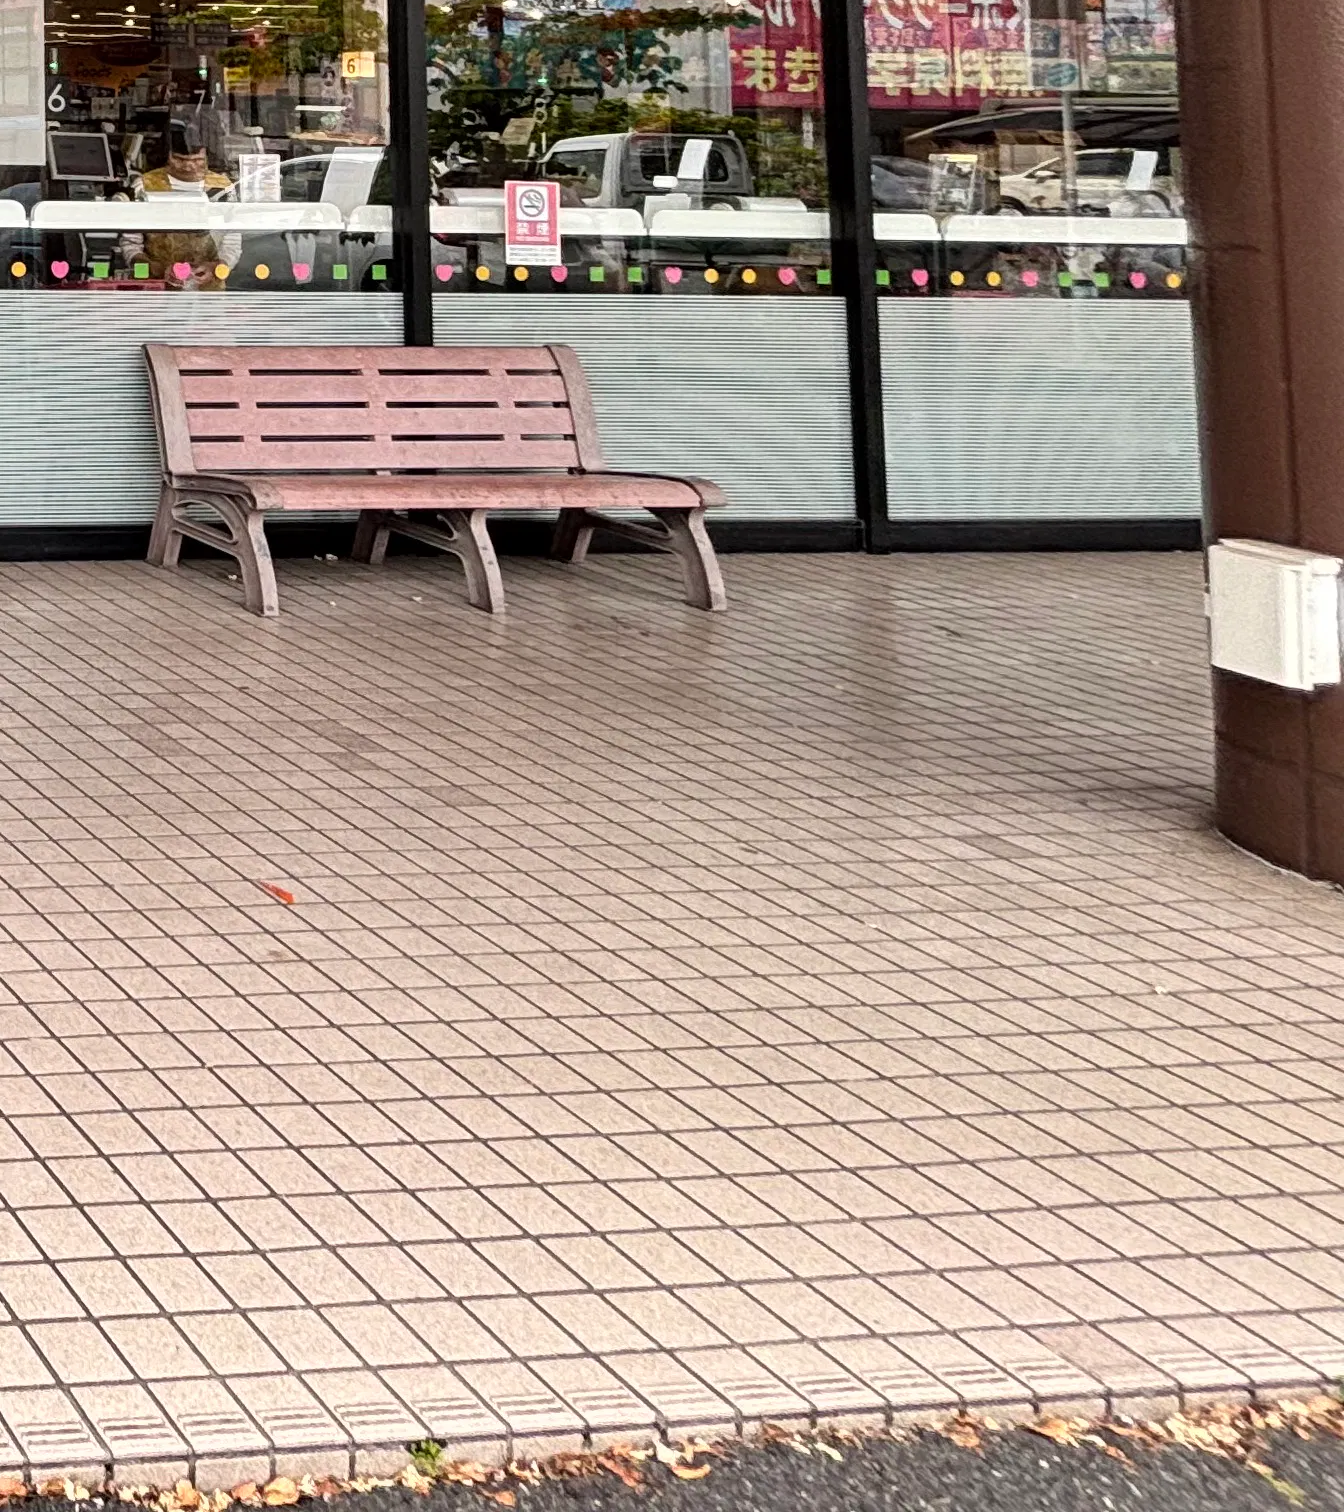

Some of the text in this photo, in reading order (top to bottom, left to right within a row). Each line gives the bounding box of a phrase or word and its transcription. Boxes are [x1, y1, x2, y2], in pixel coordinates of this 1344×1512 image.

[347, 58, 356, 74] 6
[47, 83, 67, 113] 6
[194, 89, 207, 115] 7
